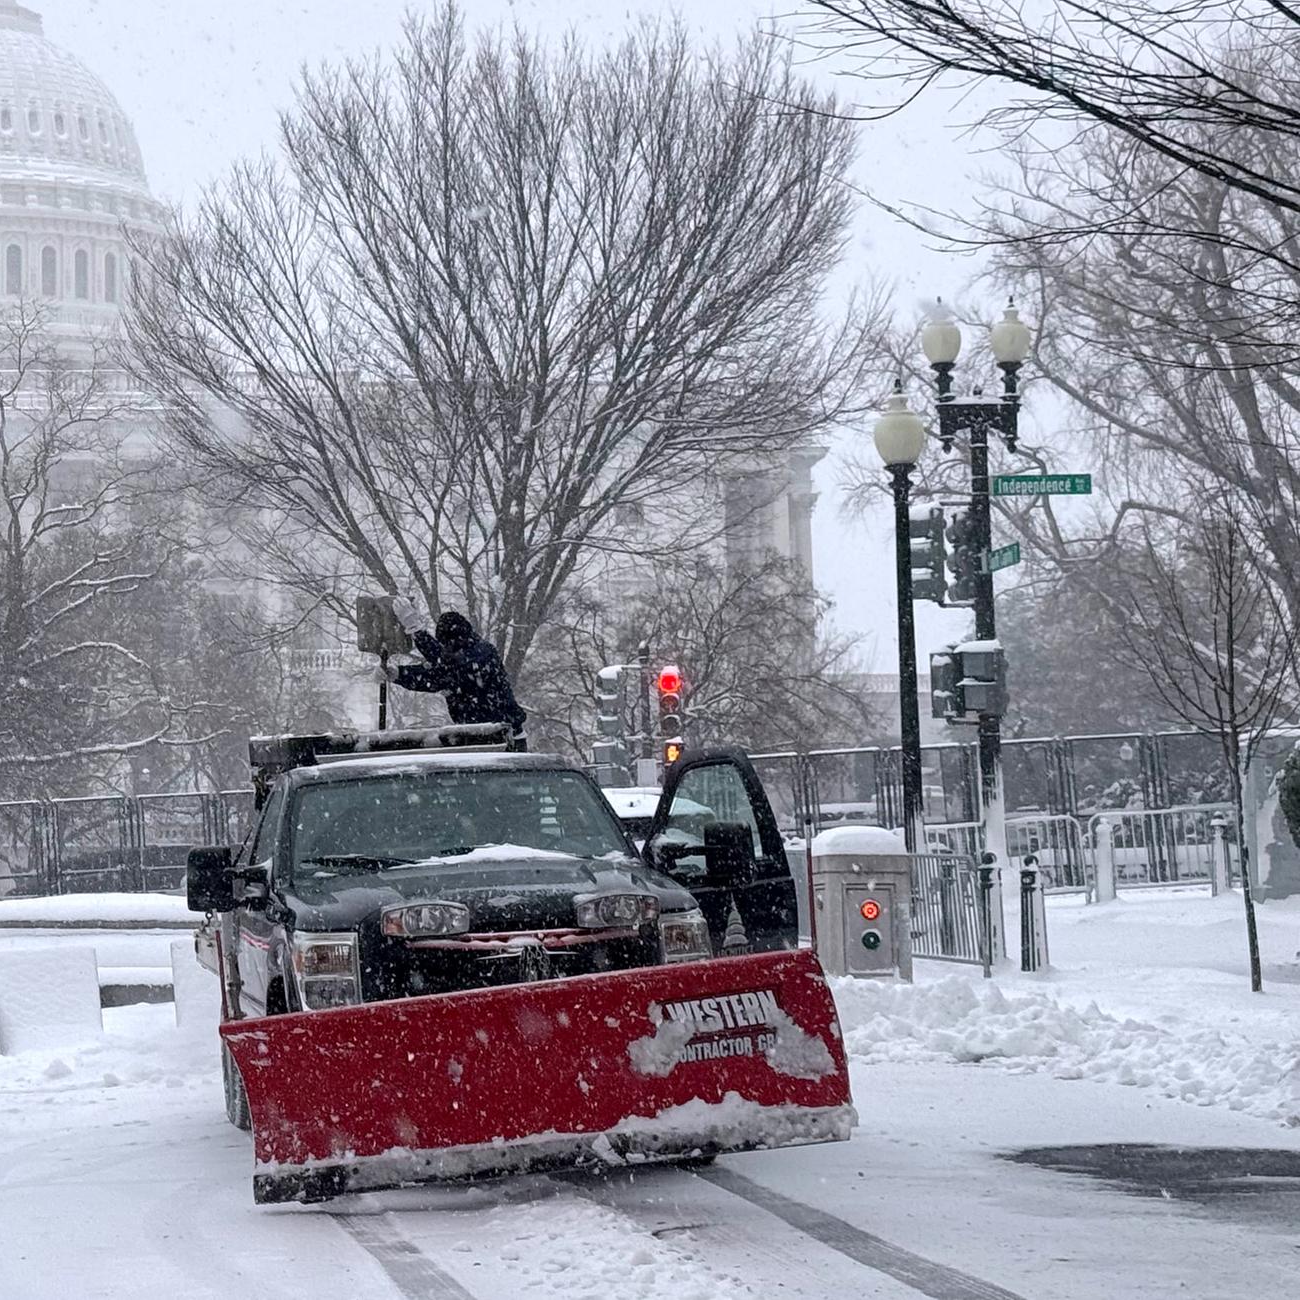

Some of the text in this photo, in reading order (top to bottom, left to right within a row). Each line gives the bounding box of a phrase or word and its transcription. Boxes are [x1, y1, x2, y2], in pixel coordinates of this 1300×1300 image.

[998, 478, 1072, 494] Independence
[666, 990, 778, 1032] WESTERN
[680, 1036, 753, 1062] ONTRACTOR
